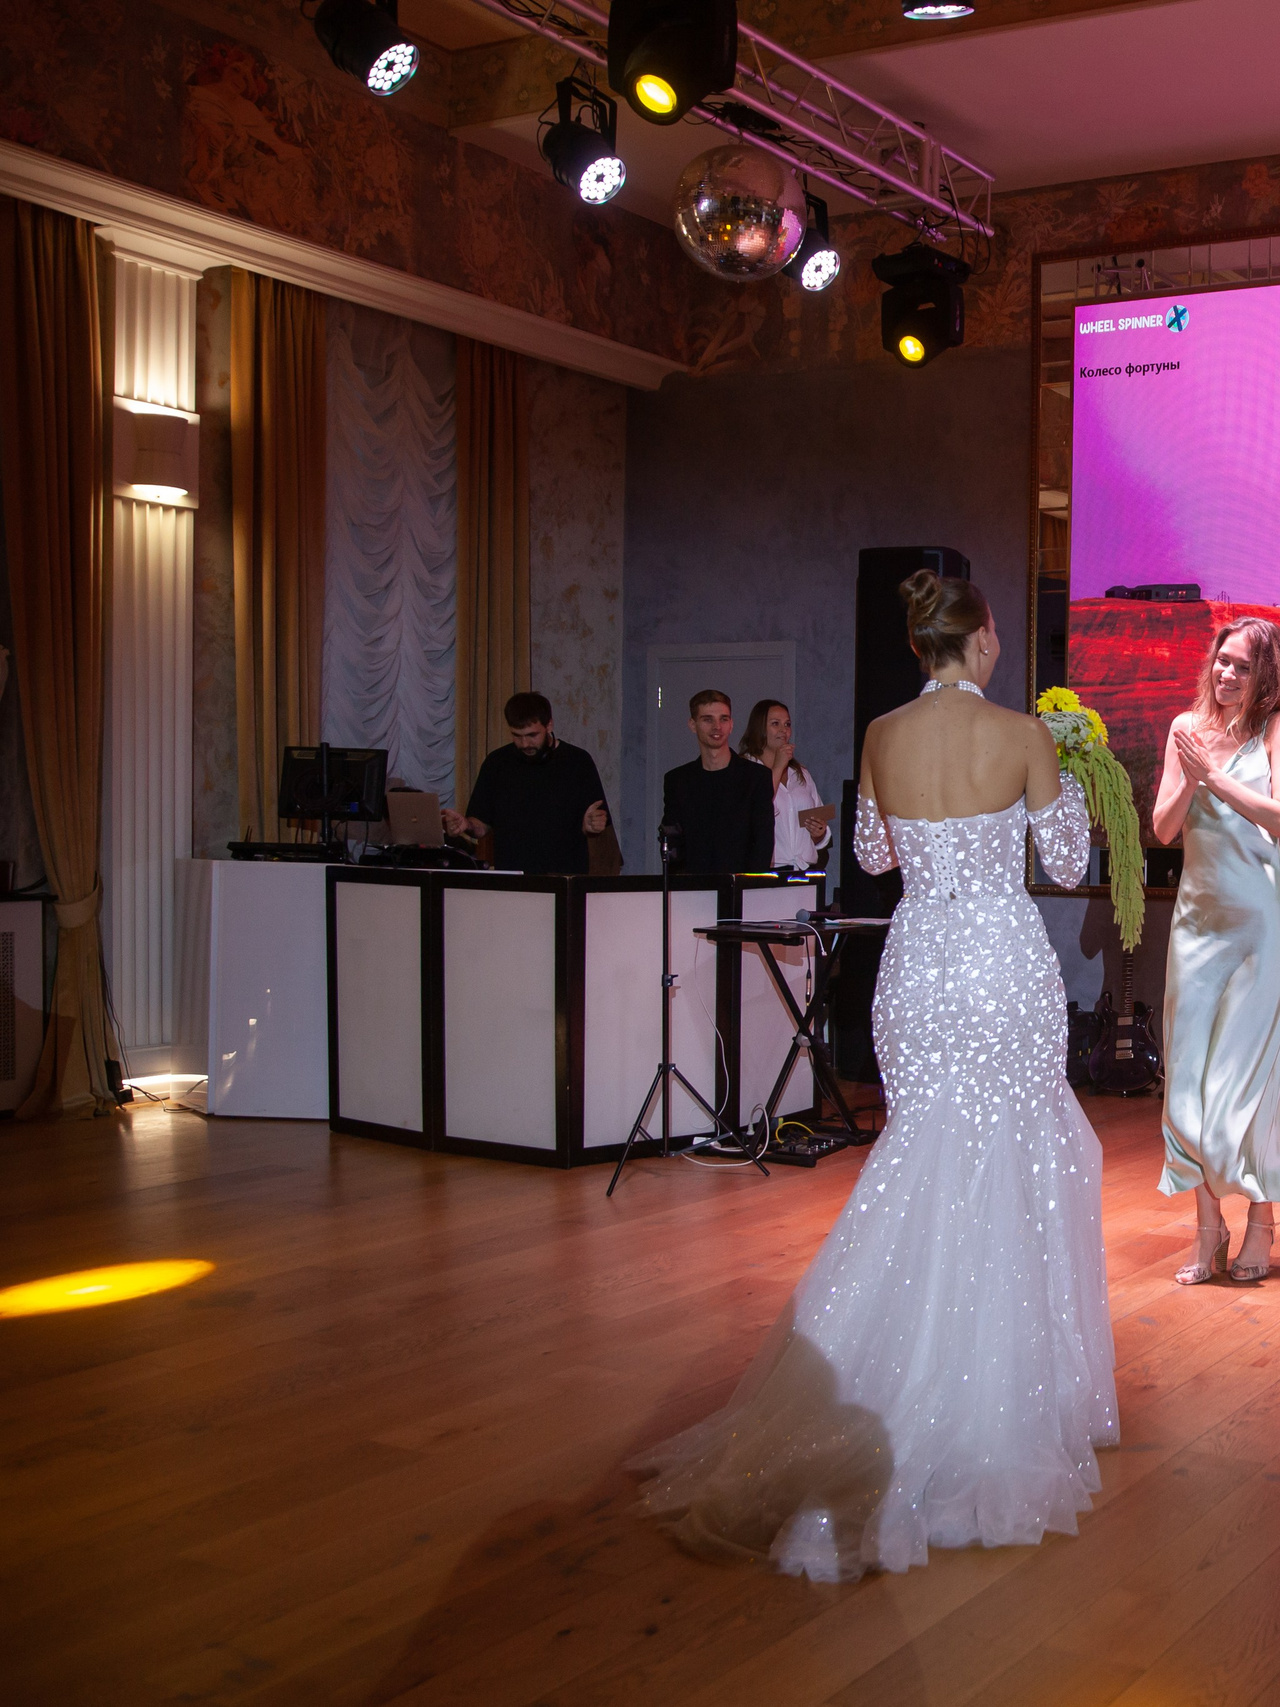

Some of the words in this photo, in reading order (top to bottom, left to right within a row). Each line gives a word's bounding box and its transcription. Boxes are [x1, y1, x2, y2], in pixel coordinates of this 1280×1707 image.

[1079, 319, 1116, 335] WHEEL
[1118, 314, 1163, 331] SPINNER
[1079, 366, 1122, 378] Колесо
[1125, 361, 1180, 377] фортуны
